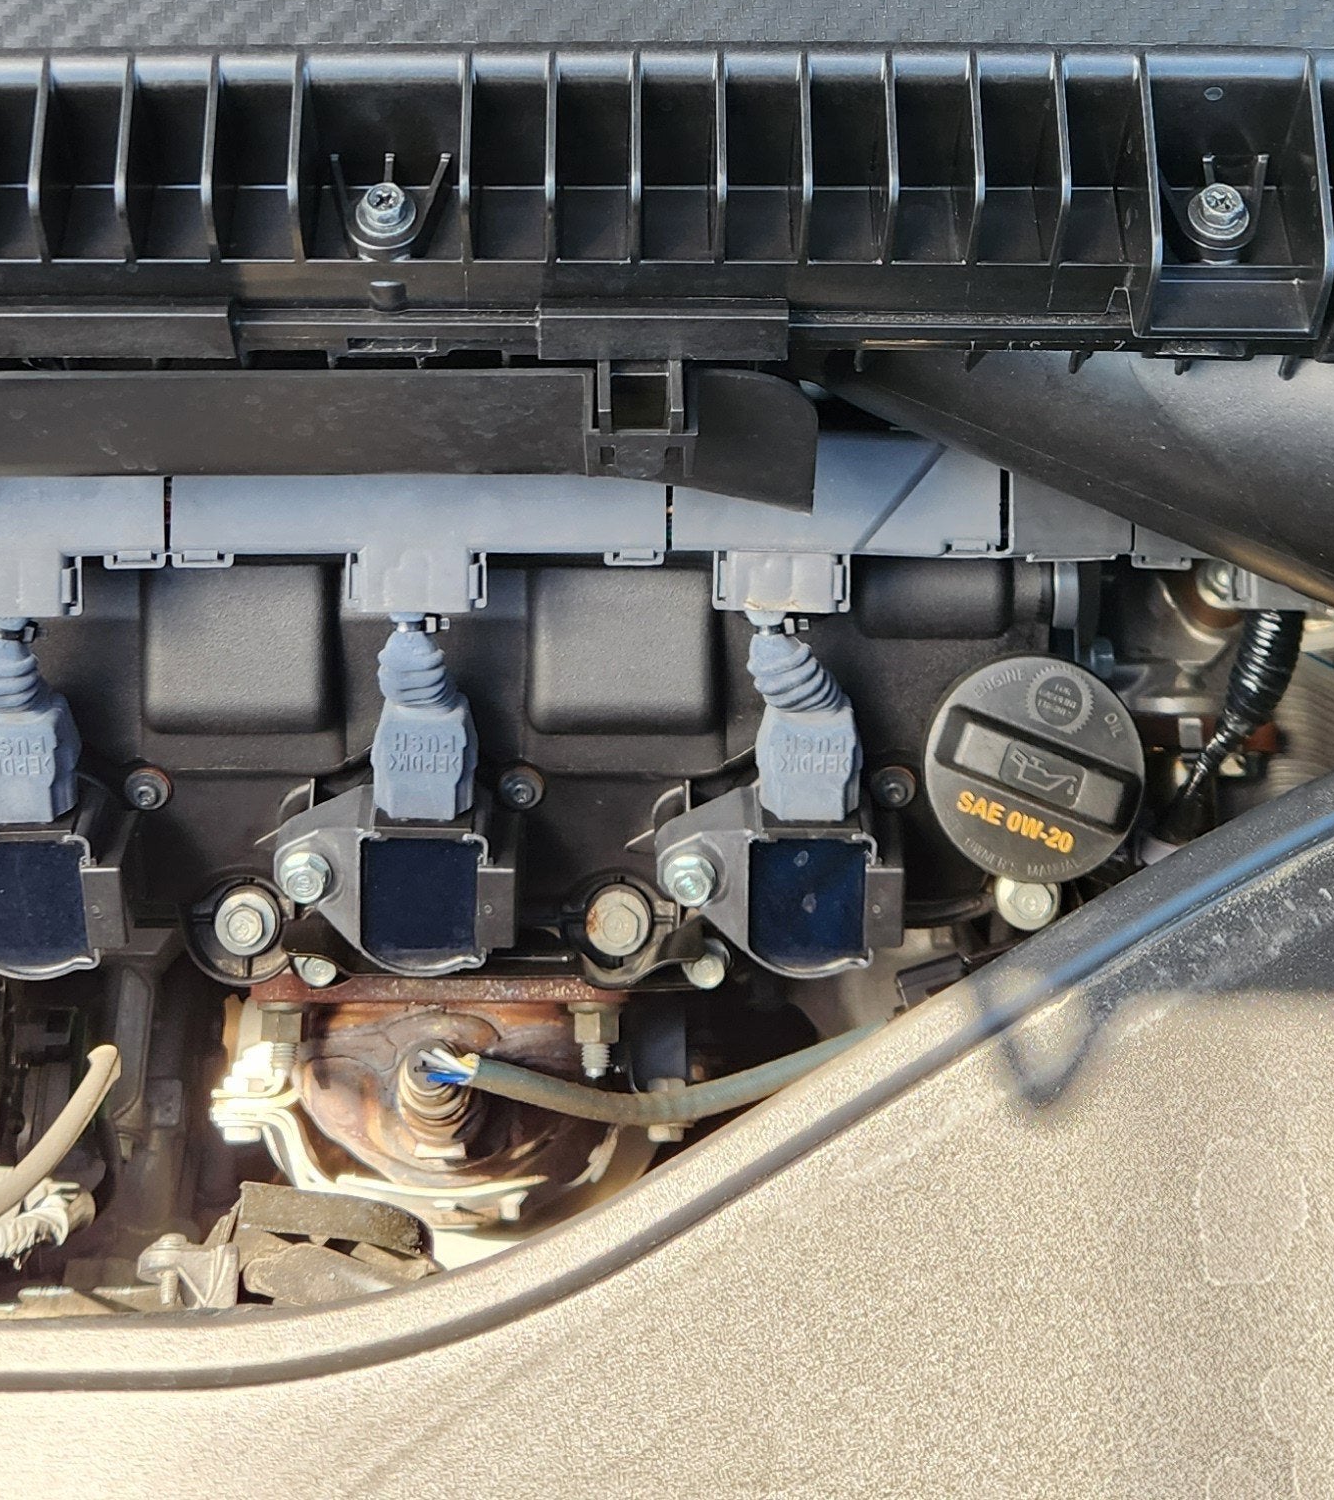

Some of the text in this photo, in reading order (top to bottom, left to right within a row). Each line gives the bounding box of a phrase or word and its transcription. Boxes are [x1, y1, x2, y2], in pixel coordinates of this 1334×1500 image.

[1104, 712, 1124, 738] OIL
[393, 733, 457, 755] PUSH
[785, 735, 846, 756] PUSH
[956, 790, 1076, 854] SAE 0W-20
